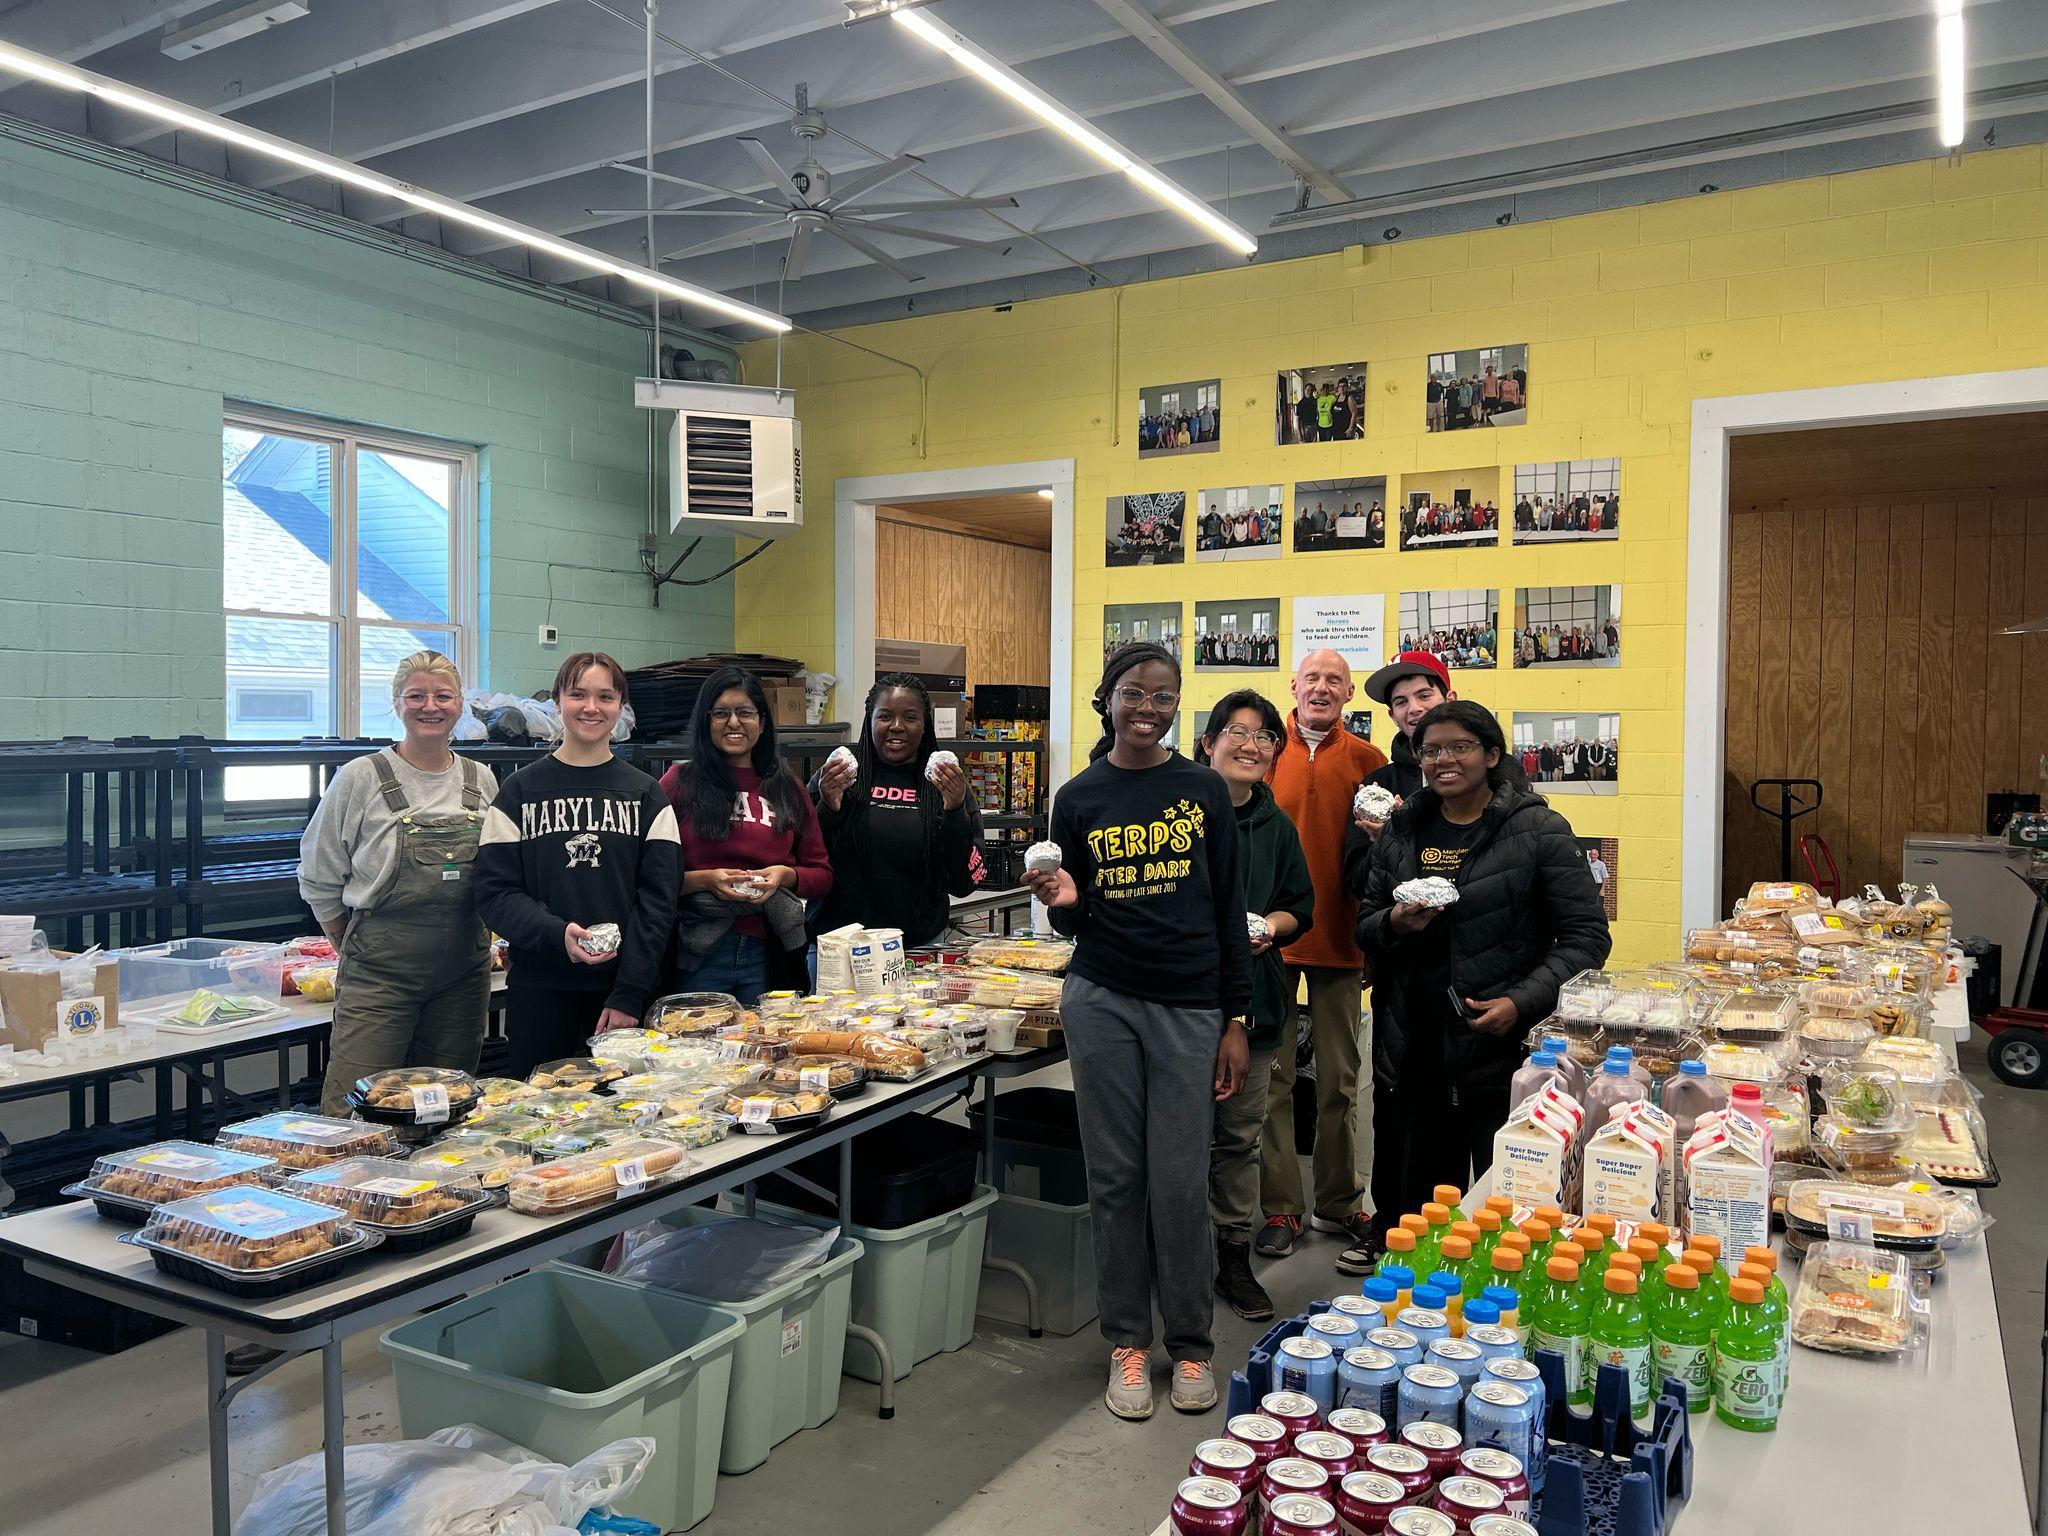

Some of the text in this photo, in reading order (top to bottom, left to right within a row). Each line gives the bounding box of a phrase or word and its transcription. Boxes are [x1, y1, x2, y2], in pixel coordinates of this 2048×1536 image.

[794, 447, 802, 505] REZNOR
[1087, 819, 1193, 863] TERPS
[1095, 860, 1191, 886] FTER DARK
[1104, 889, 1125, 899] STAYING
[1125, 888, 1133, 898] UP
[1133, 886, 1146, 897] LATE
[1146, 884, 1162, 895] SINCE
[72, 1001, 98, 1012] LIONS
[79, 1012, 89, 1025] L
[1035, 1015, 1062, 1026] PIZZA
[1504, 1144, 1549, 1157] Super Duper
[1510, 1152, 1544, 1163] Delicious
[1596, 1158, 1642, 1170] Super Duper
[1601, 1166, 1637, 1176] Delicious
[1730, 1379, 1770, 1397] ZERO
[1184, 1514, 1204, 1524] CALORIES
